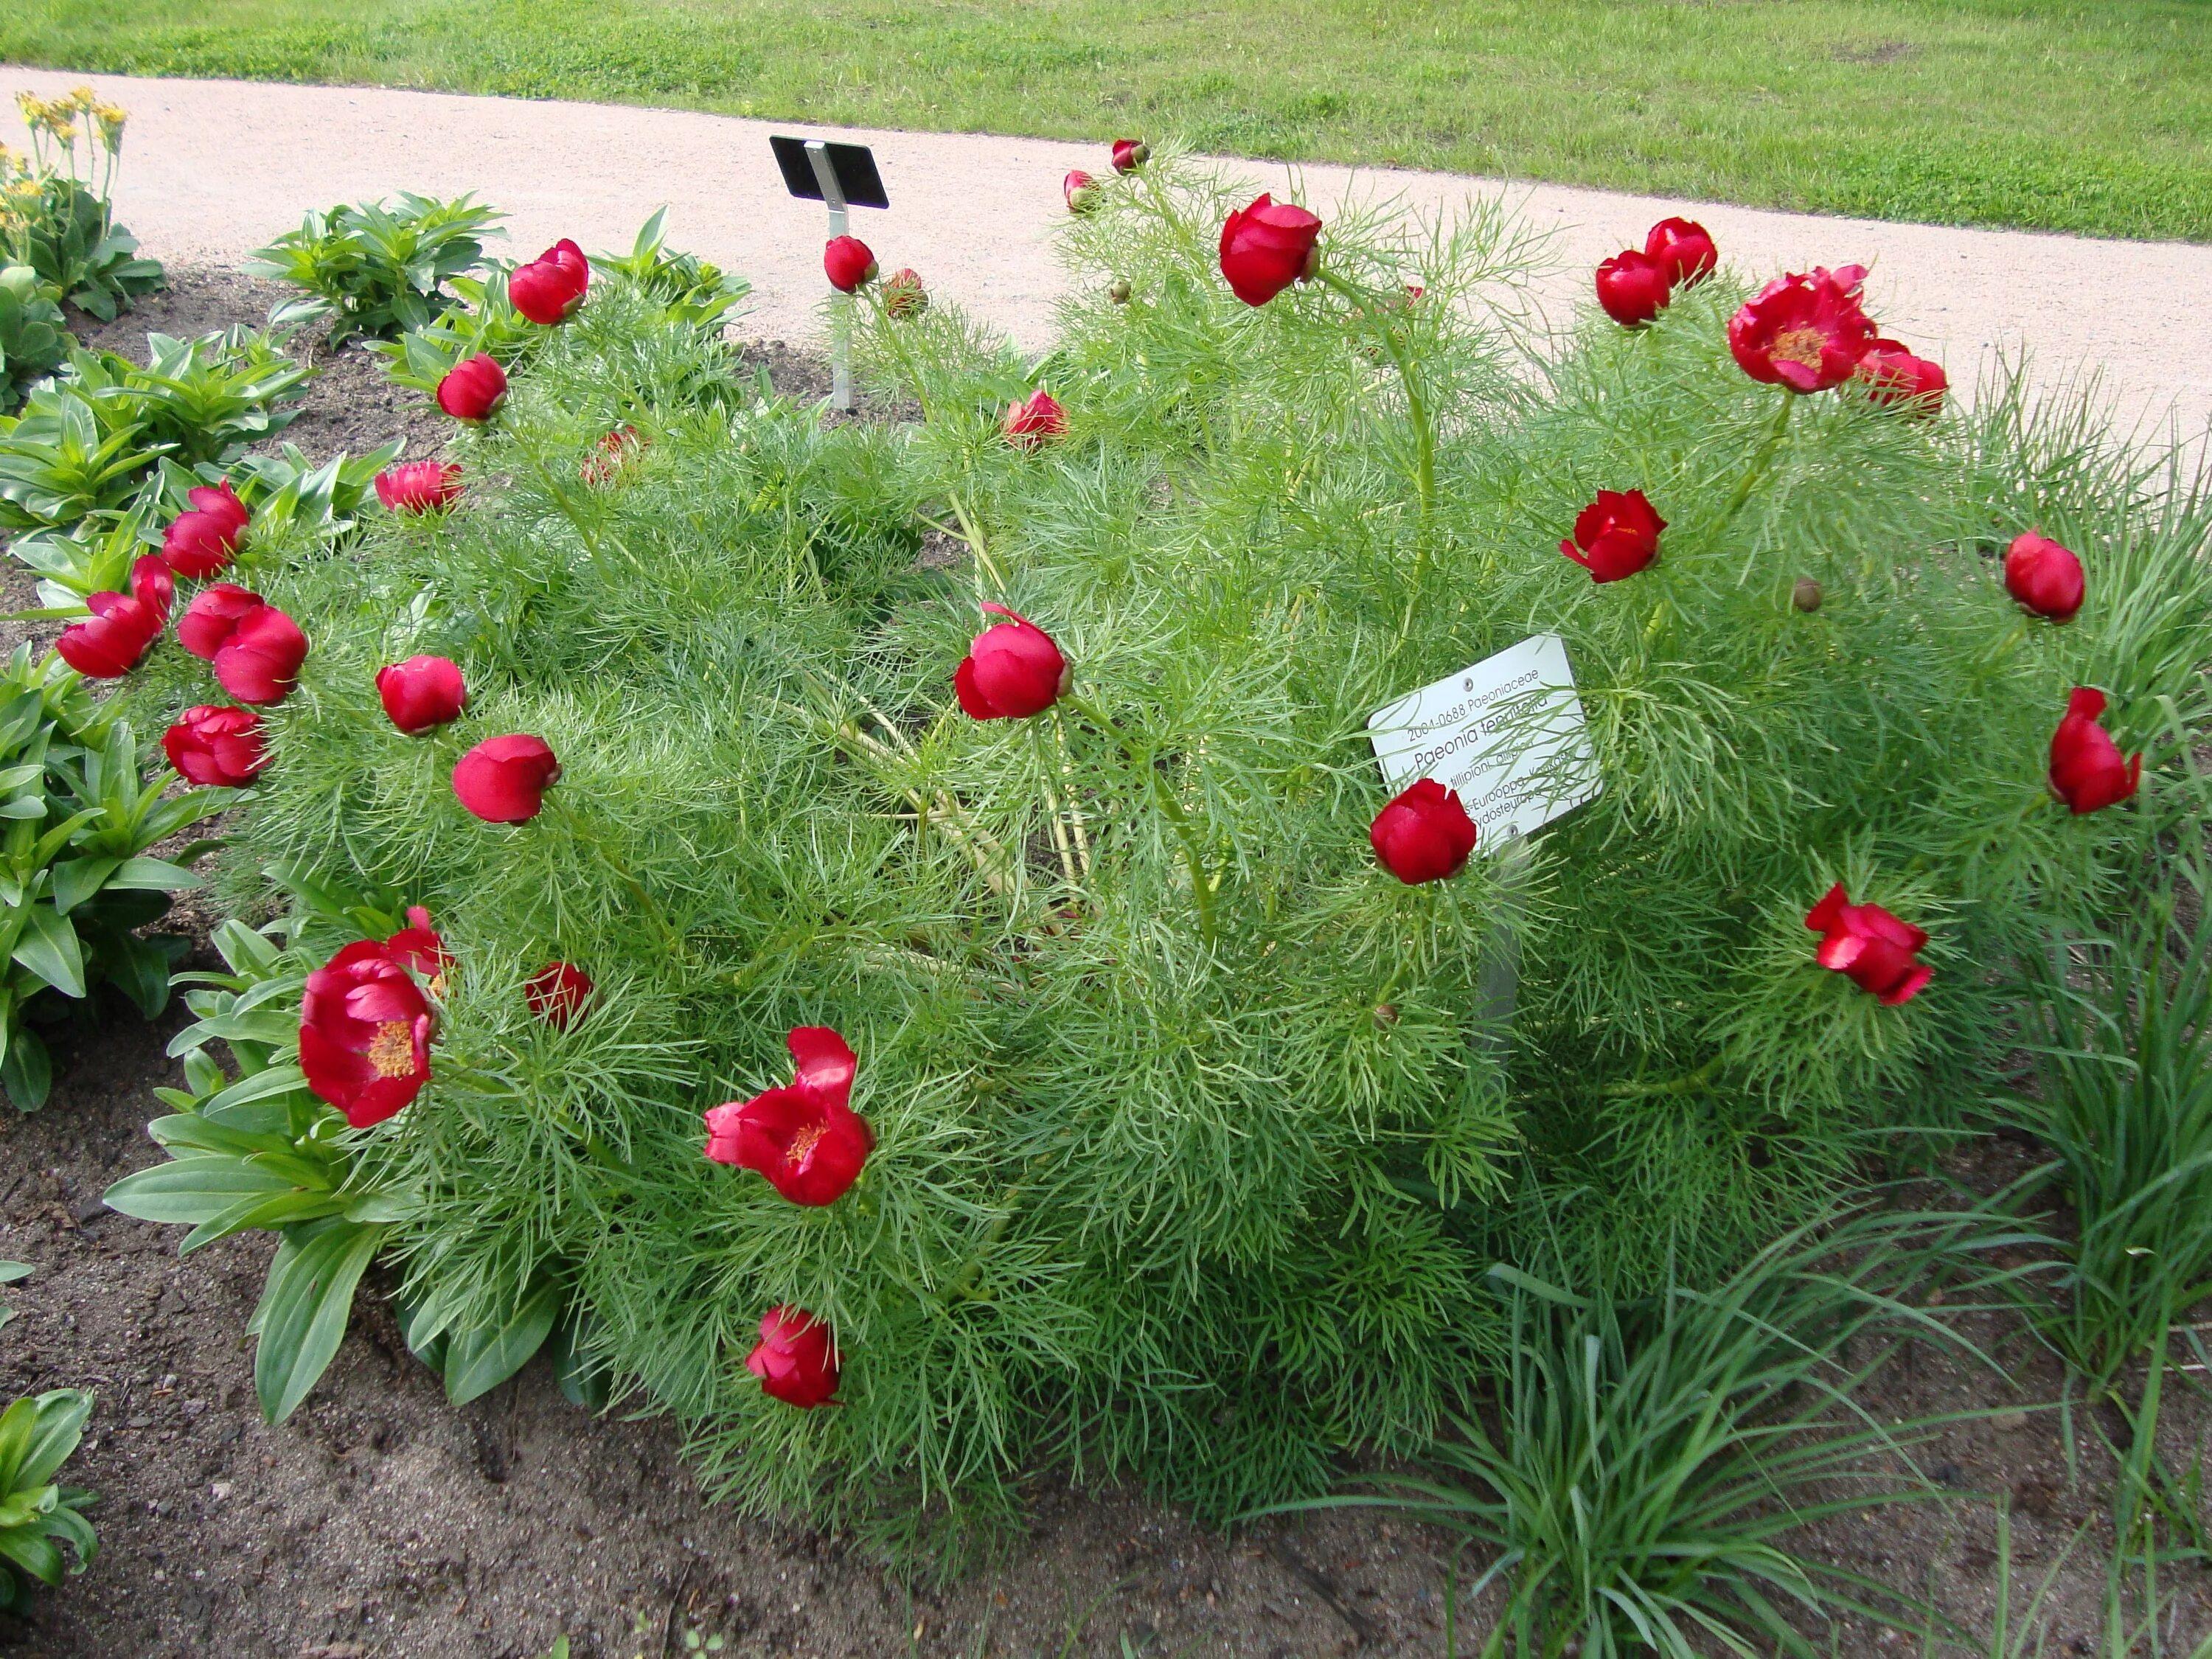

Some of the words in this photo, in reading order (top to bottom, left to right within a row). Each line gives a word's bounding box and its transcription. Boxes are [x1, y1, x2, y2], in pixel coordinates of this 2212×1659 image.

[1408, 703, 1466, 742] 2004-0688
[1468, 669, 1539, 712] Paeoniaceae
[1415, 728, 1478, 771] Paeonia
[1466, 776, 1525, 815] s-Eurooppa
